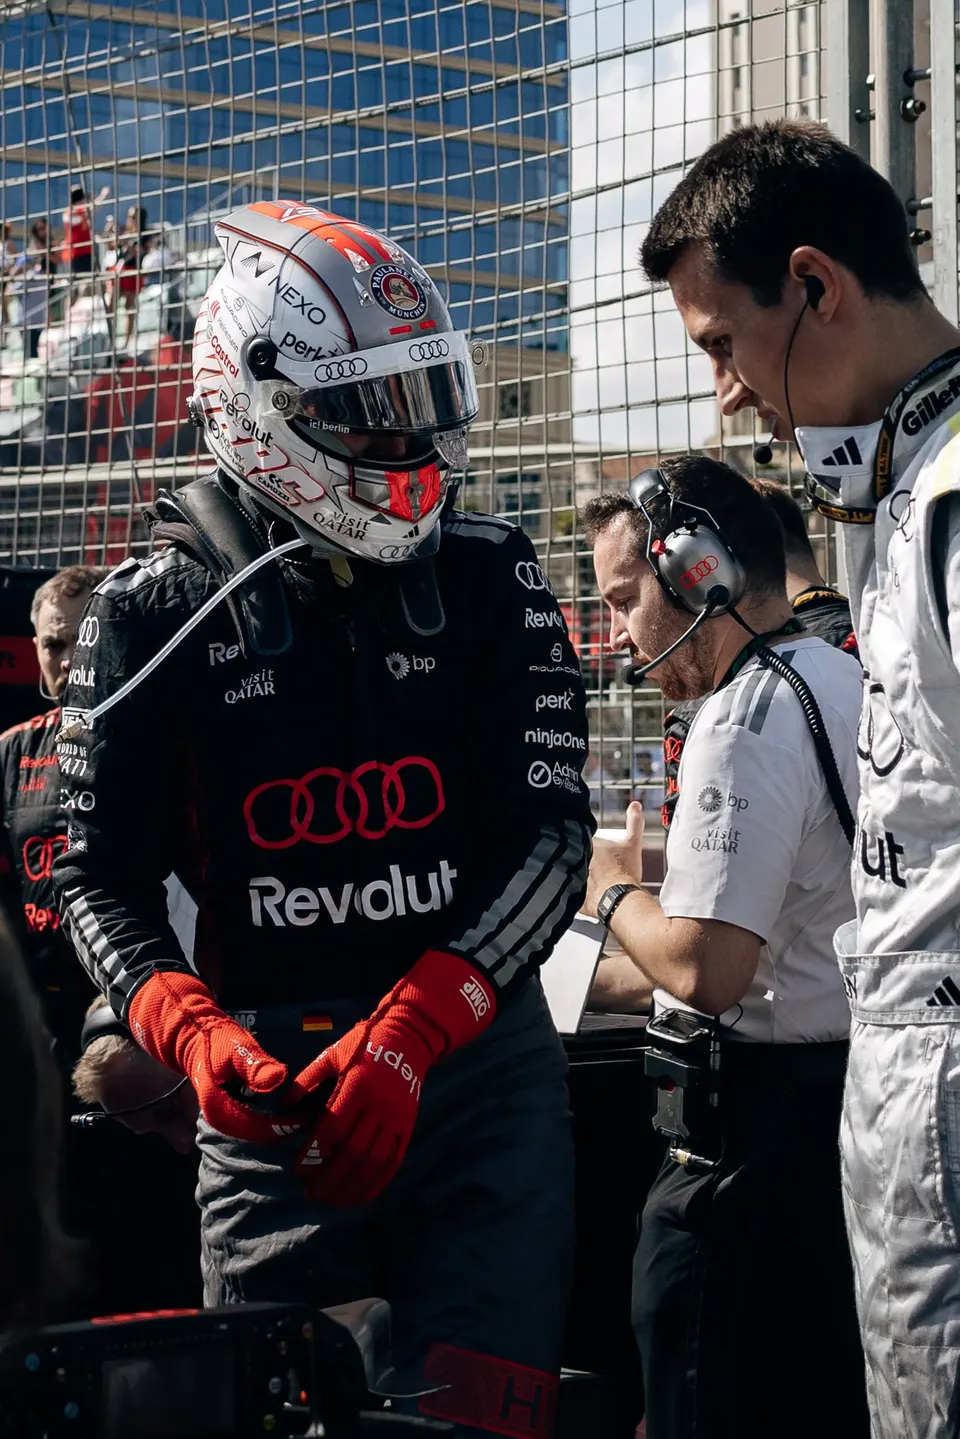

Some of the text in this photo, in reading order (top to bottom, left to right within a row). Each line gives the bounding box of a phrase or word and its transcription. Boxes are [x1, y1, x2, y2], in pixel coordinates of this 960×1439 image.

[268, 275, 326, 325] NEXO
[388, 301, 426, 318] MÜNCHEN
[211, 335, 240, 378] Castrol
[219, 389, 274, 448] Revolut
[309, 419, 350, 434] ic! berlin
[257, 476, 290, 502] CAMOZZI
[312, 512, 366, 541] QATAR
[333, 511, 371, 531] visit
[412, 655, 436, 673] bp
[241, 669, 275, 687] visit
[224, 681, 276, 704] QATAR
[535, 691, 572, 712] perk
[525, 728, 586, 749] ninjaOne
[727, 791, 750, 812] bp
[707, 826, 742, 842] visit
[691, 837, 740, 855] QATAR
[248, 859, 458, 927] Revolut
[463, 981, 487, 1017] OMP
